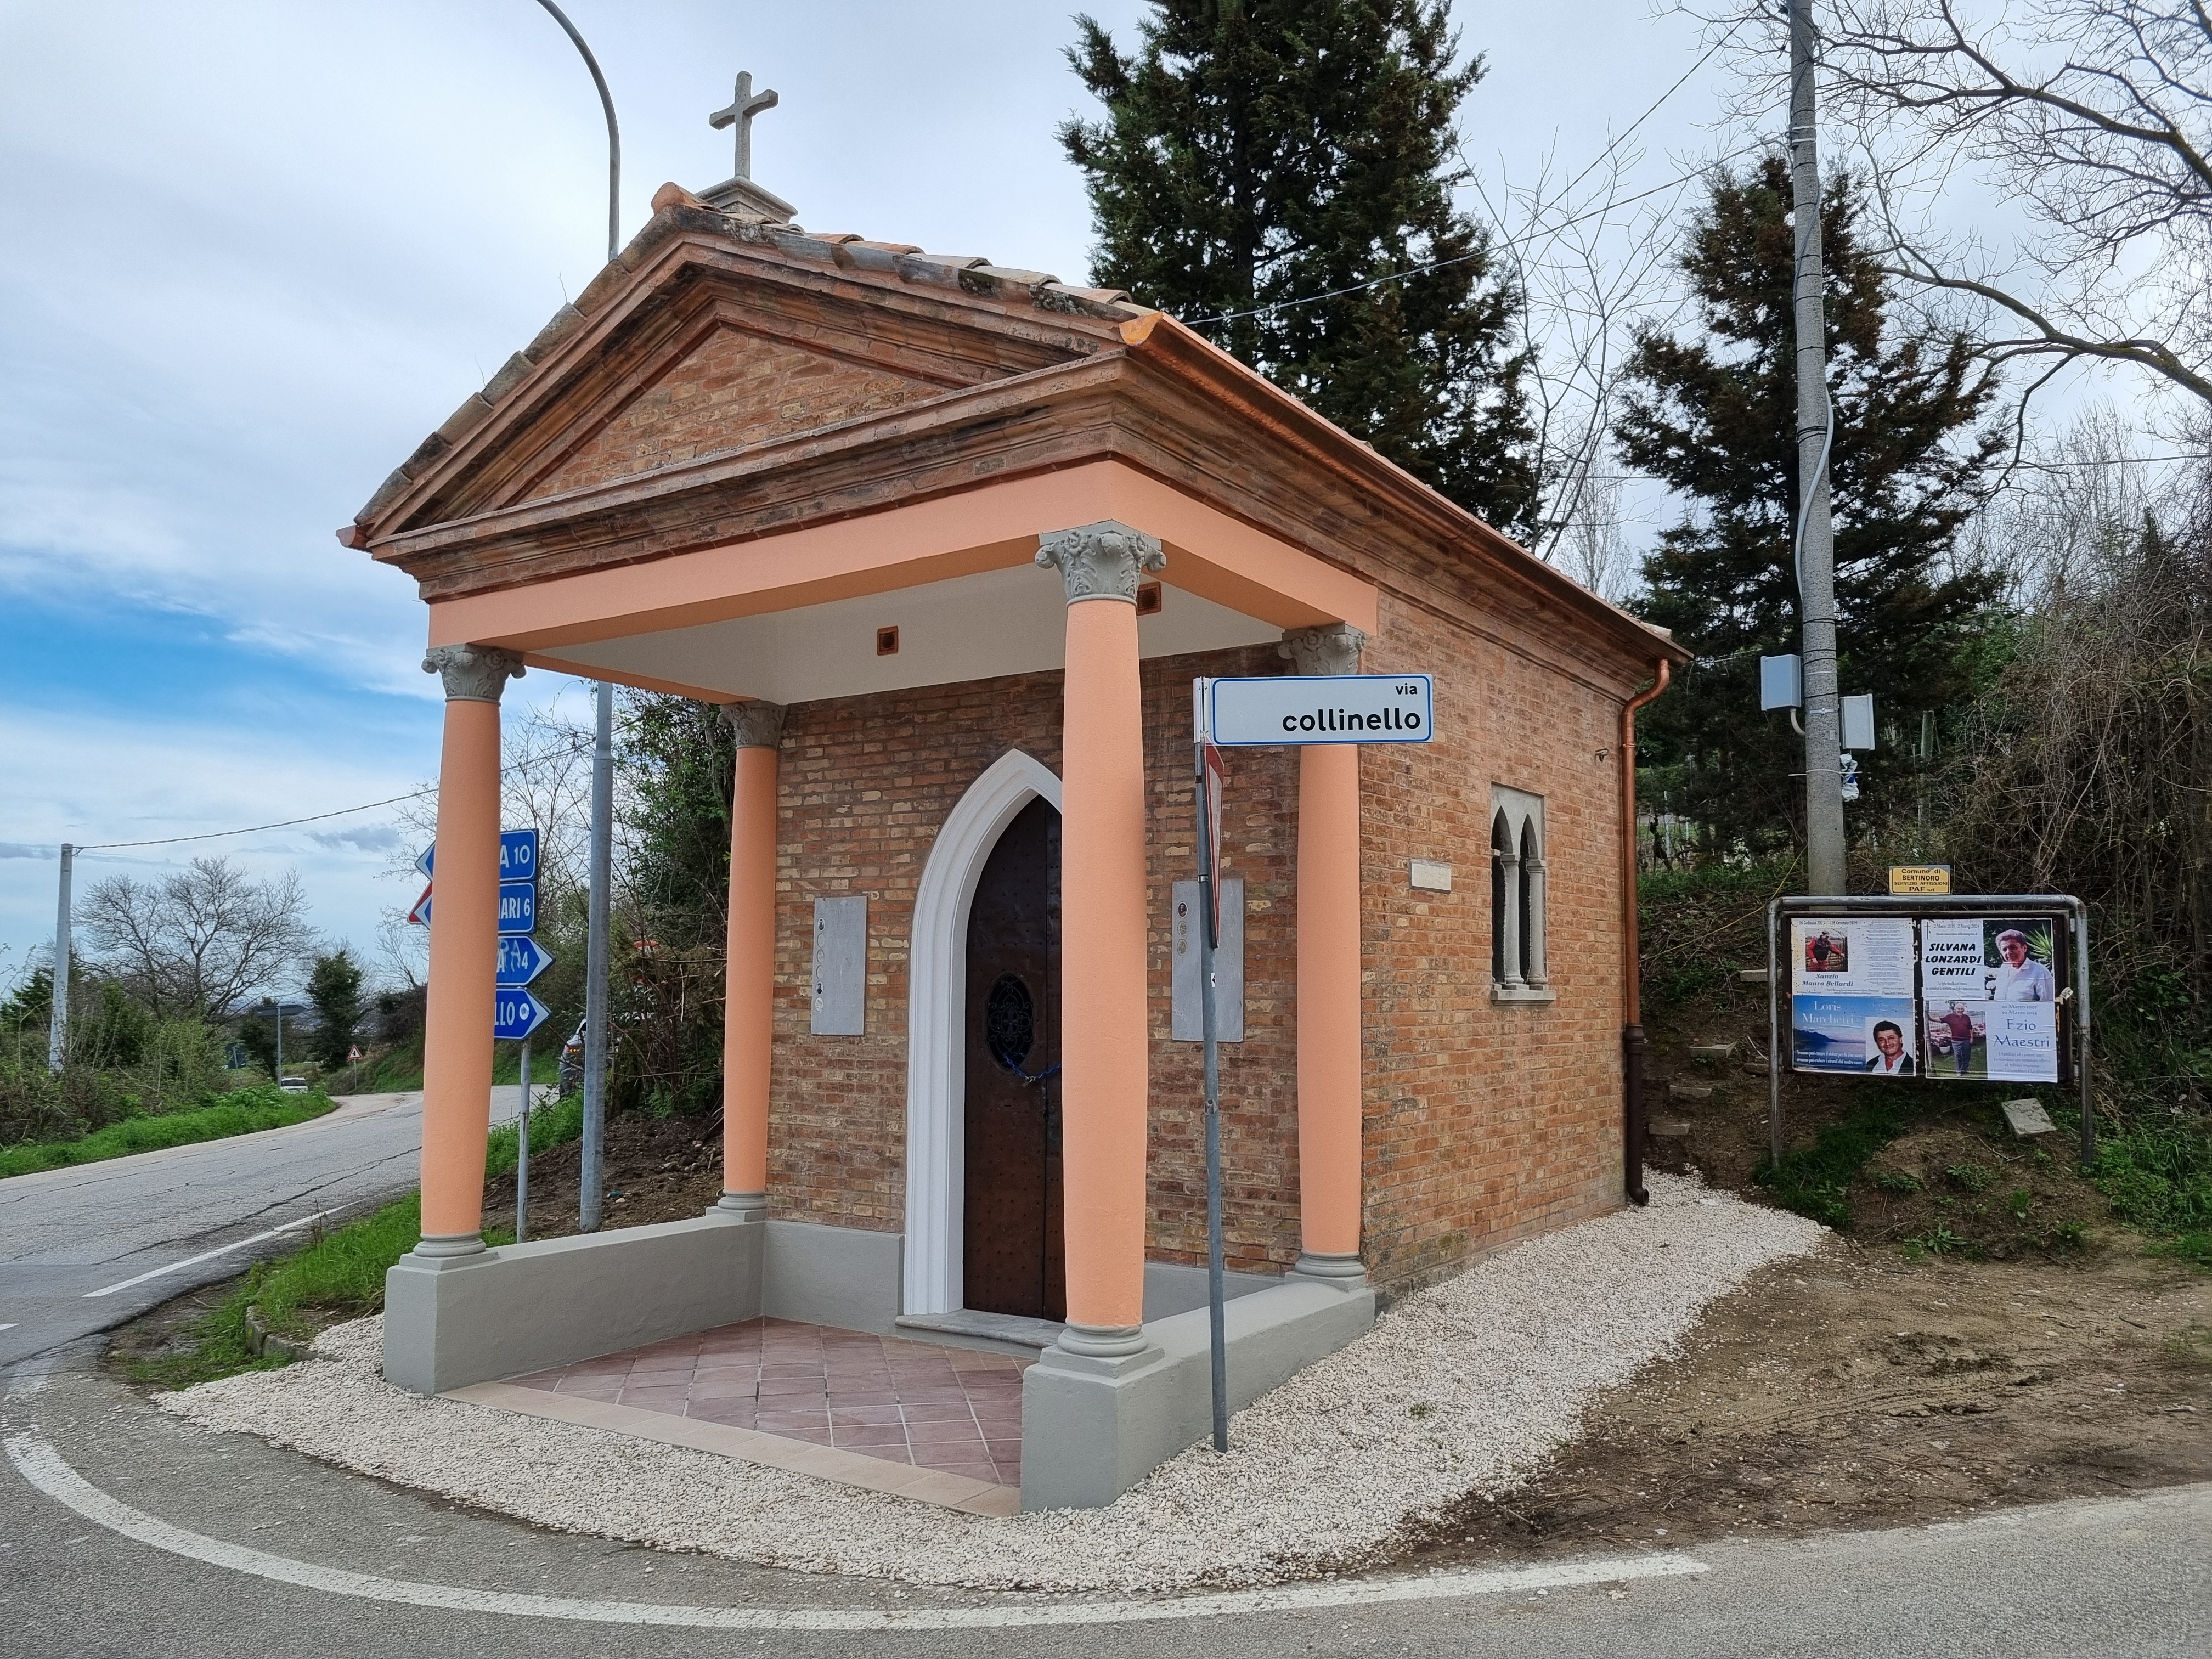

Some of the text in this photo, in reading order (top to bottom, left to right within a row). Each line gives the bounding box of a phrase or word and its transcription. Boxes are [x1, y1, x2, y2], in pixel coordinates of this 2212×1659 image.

[1395, 683, 1418, 695] via
[1282, 708, 1421, 732] collinello
[514, 845, 531, 865] 10
[524, 898, 531, 917] 6
[1929, 943, 1976, 951] SILVANA
[522, 951, 528, 969] 4
[1925, 956, 1982, 964] LONZARDI
[1932, 967, 1976, 975] GENTILI
[1815, 1001, 1841, 1011] Loris
[2006, 1018, 2036, 1030] Ezio
[1993, 1035, 2050, 1047] Maestri
